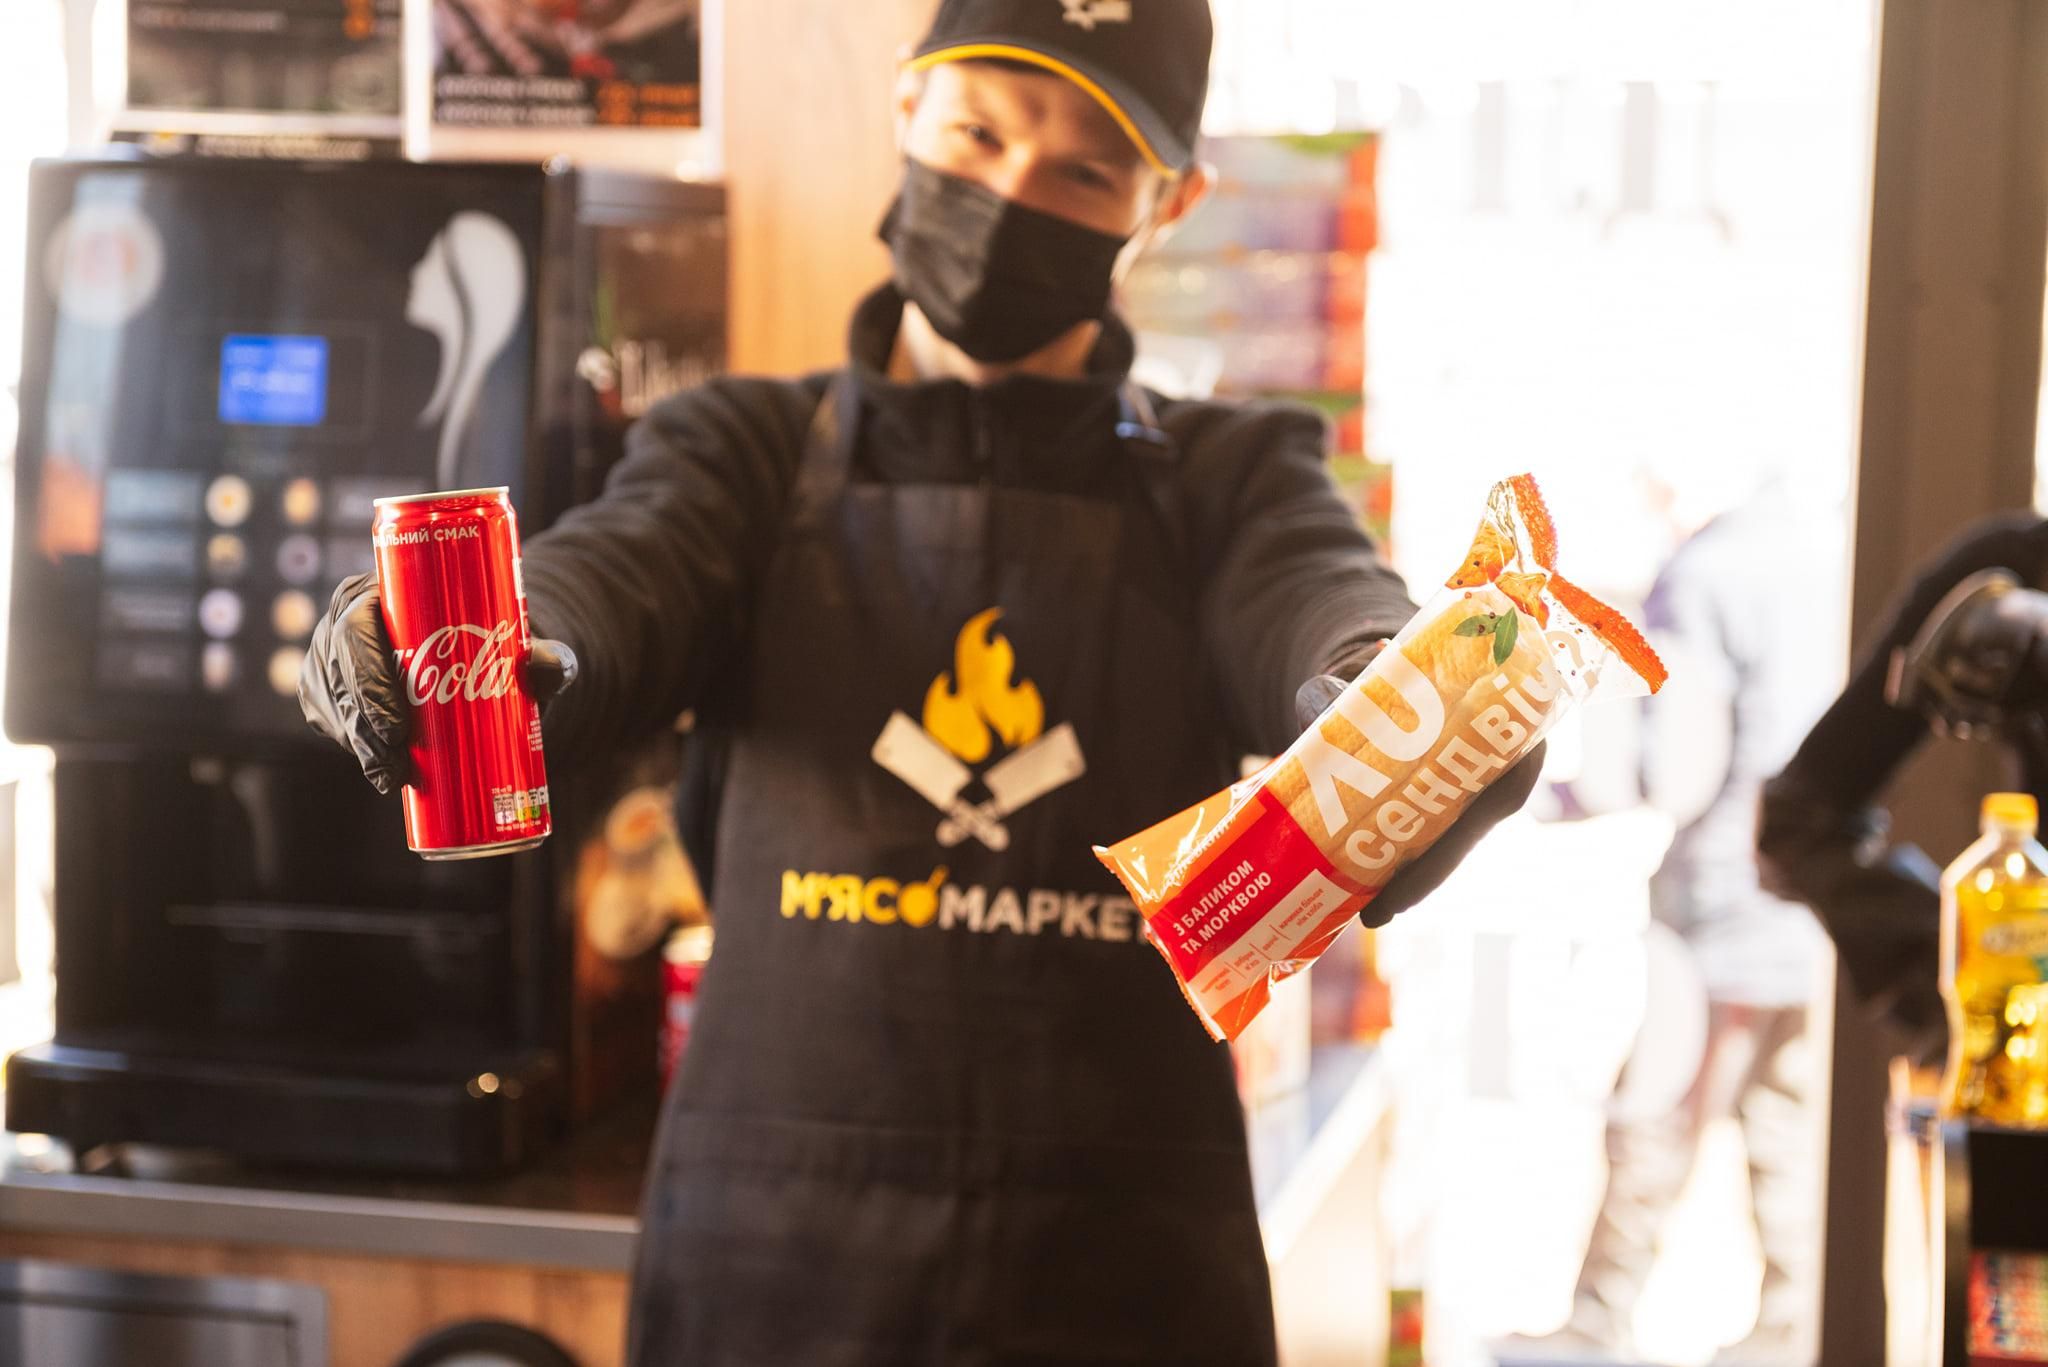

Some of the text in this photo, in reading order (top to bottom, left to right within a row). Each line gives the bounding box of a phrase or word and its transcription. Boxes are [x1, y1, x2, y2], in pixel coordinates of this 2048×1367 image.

[433, 525, 480, 542] СМАК
[1180, 871, 1272, 955] ТА МОРКВОЮ
[1181, 860, 1254, 928] БАЛИКОМ
